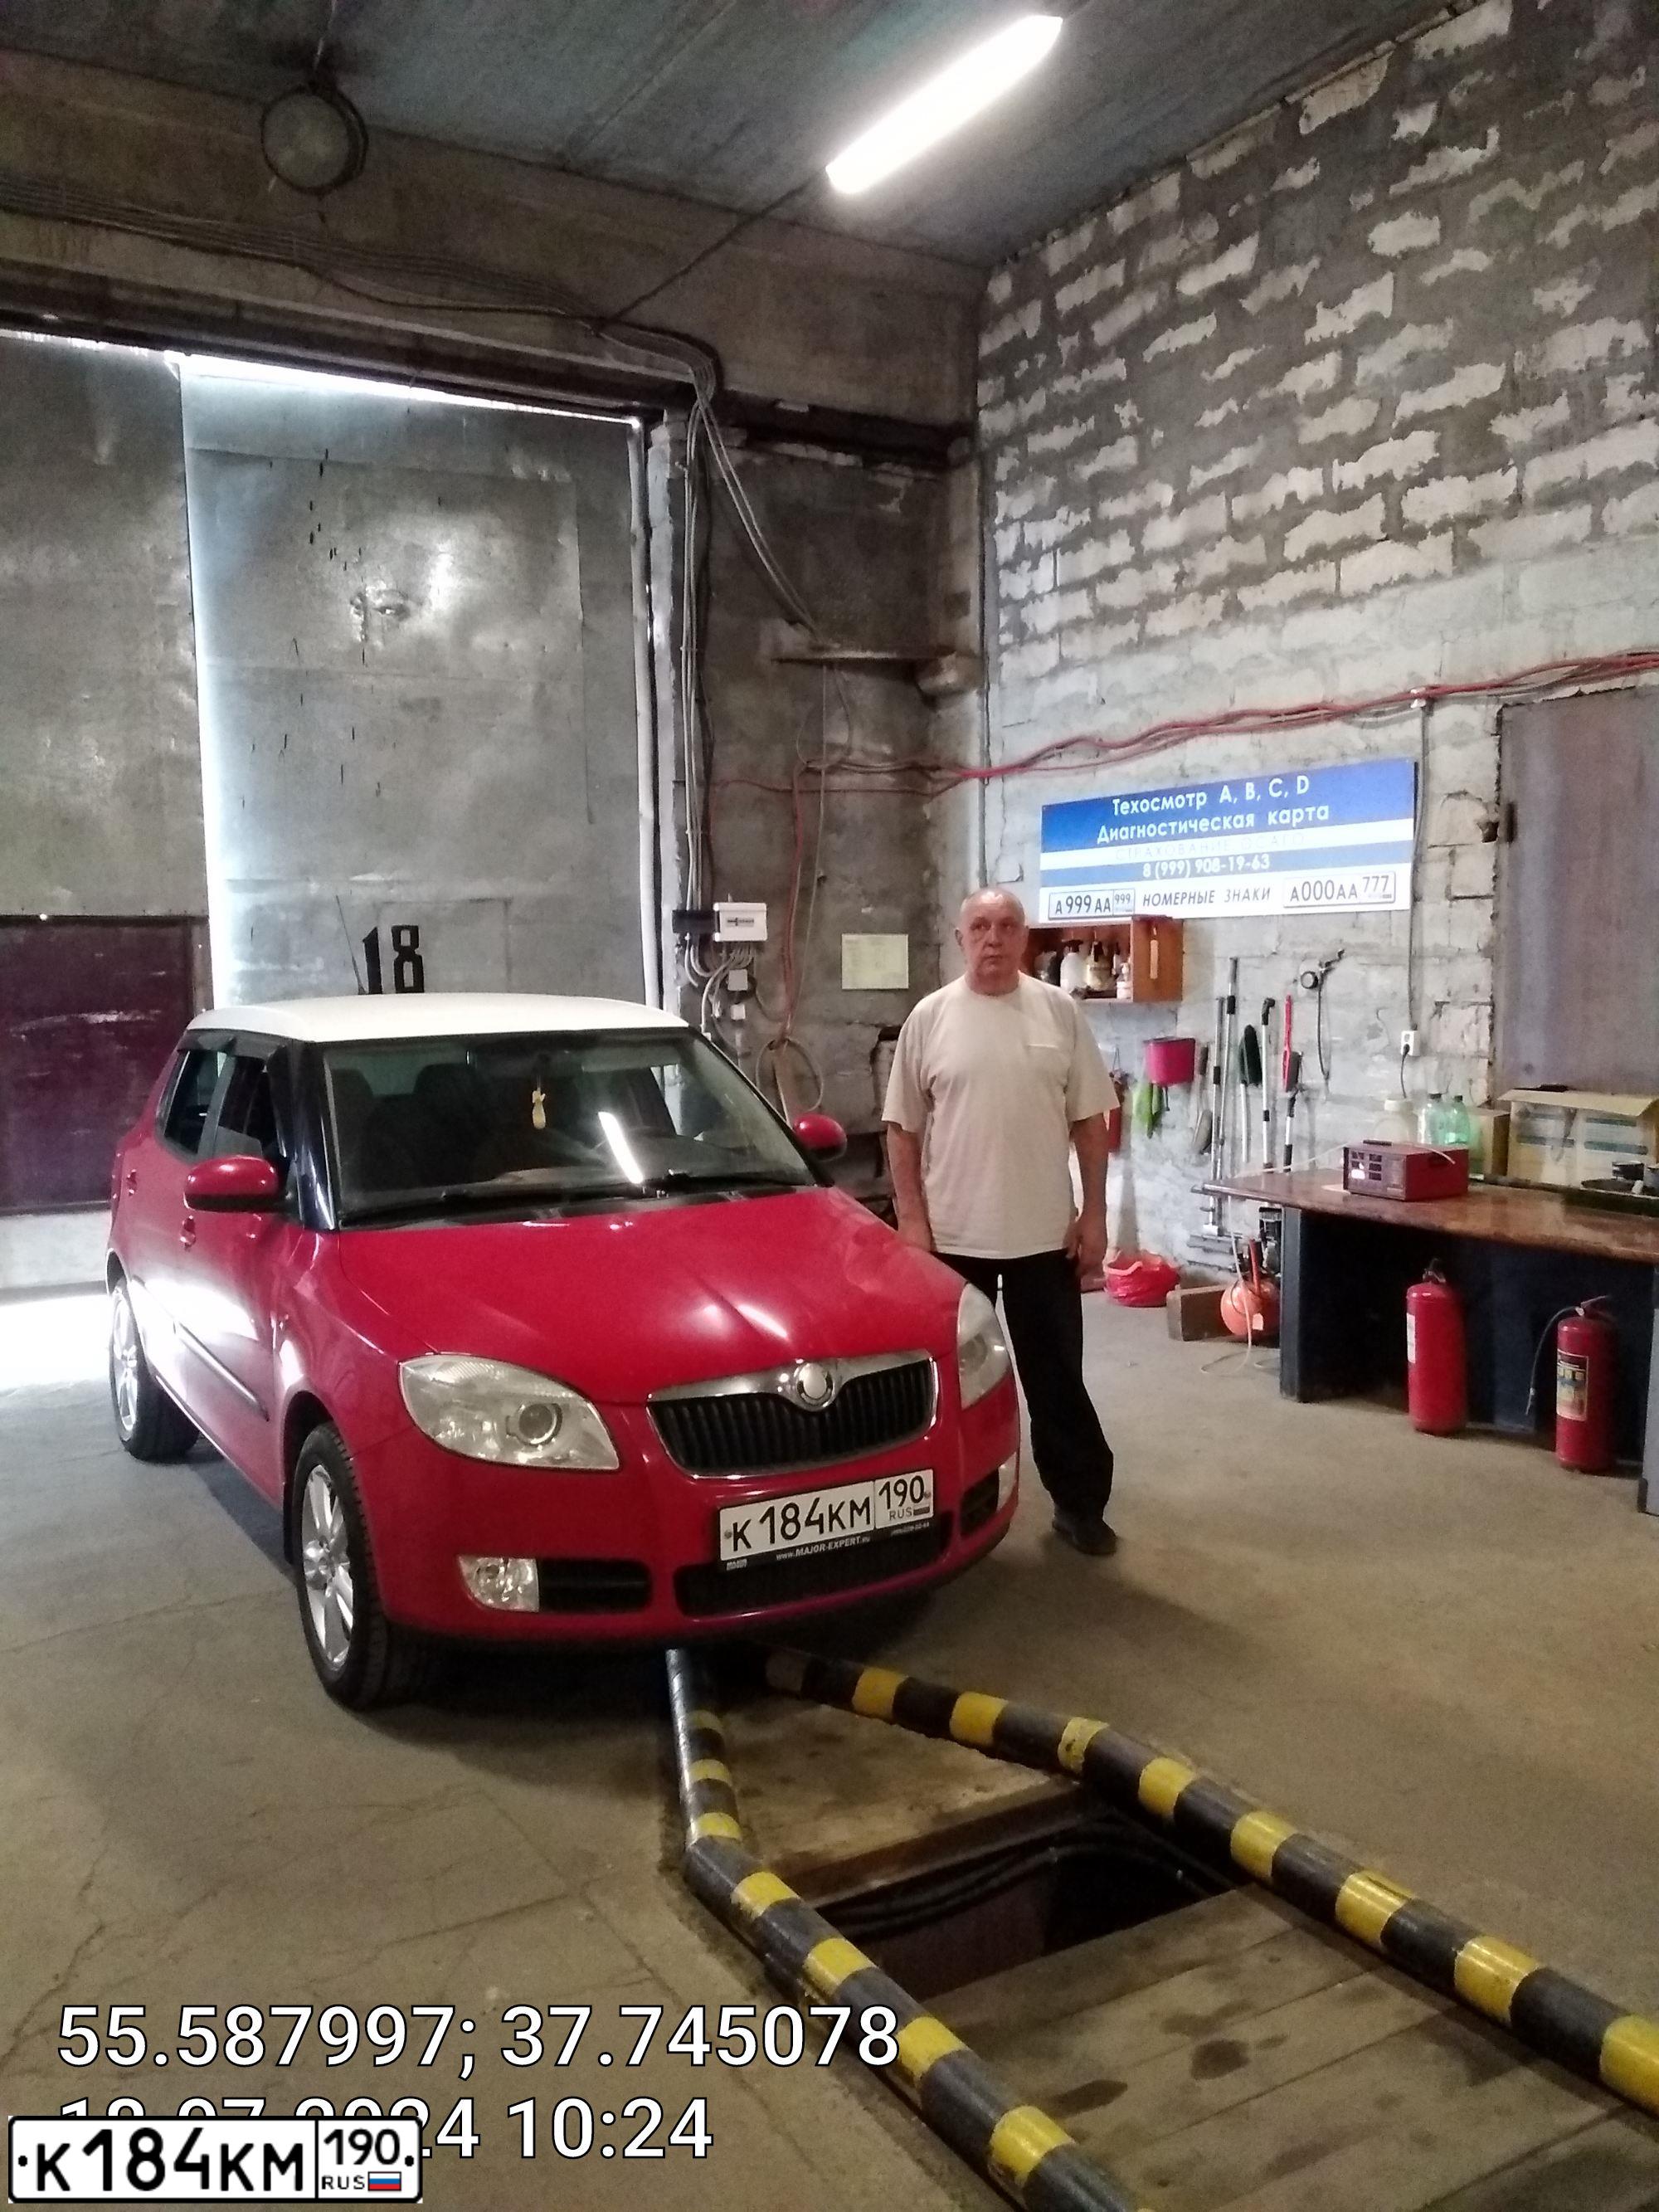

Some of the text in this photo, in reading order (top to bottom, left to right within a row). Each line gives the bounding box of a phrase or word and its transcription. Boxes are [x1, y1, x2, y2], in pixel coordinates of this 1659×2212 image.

[1112, 792, 1207, 816] Техосмотр
[1297, 776, 1310, 795] D
[1097, 805, 1329, 845] Диагностическая карта
[1142, 853, 1271, 879] 8 (999) 908-19-63
[1142, 886, 1272, 908] НОМЕРНЫЕ ЗНАКИ
[1362, 875, 1390, 894] 777
[362, 924, 425, 995] 18
[878, 1475, 926, 1511] 190
[888, 1507, 913, 1522] RUS
